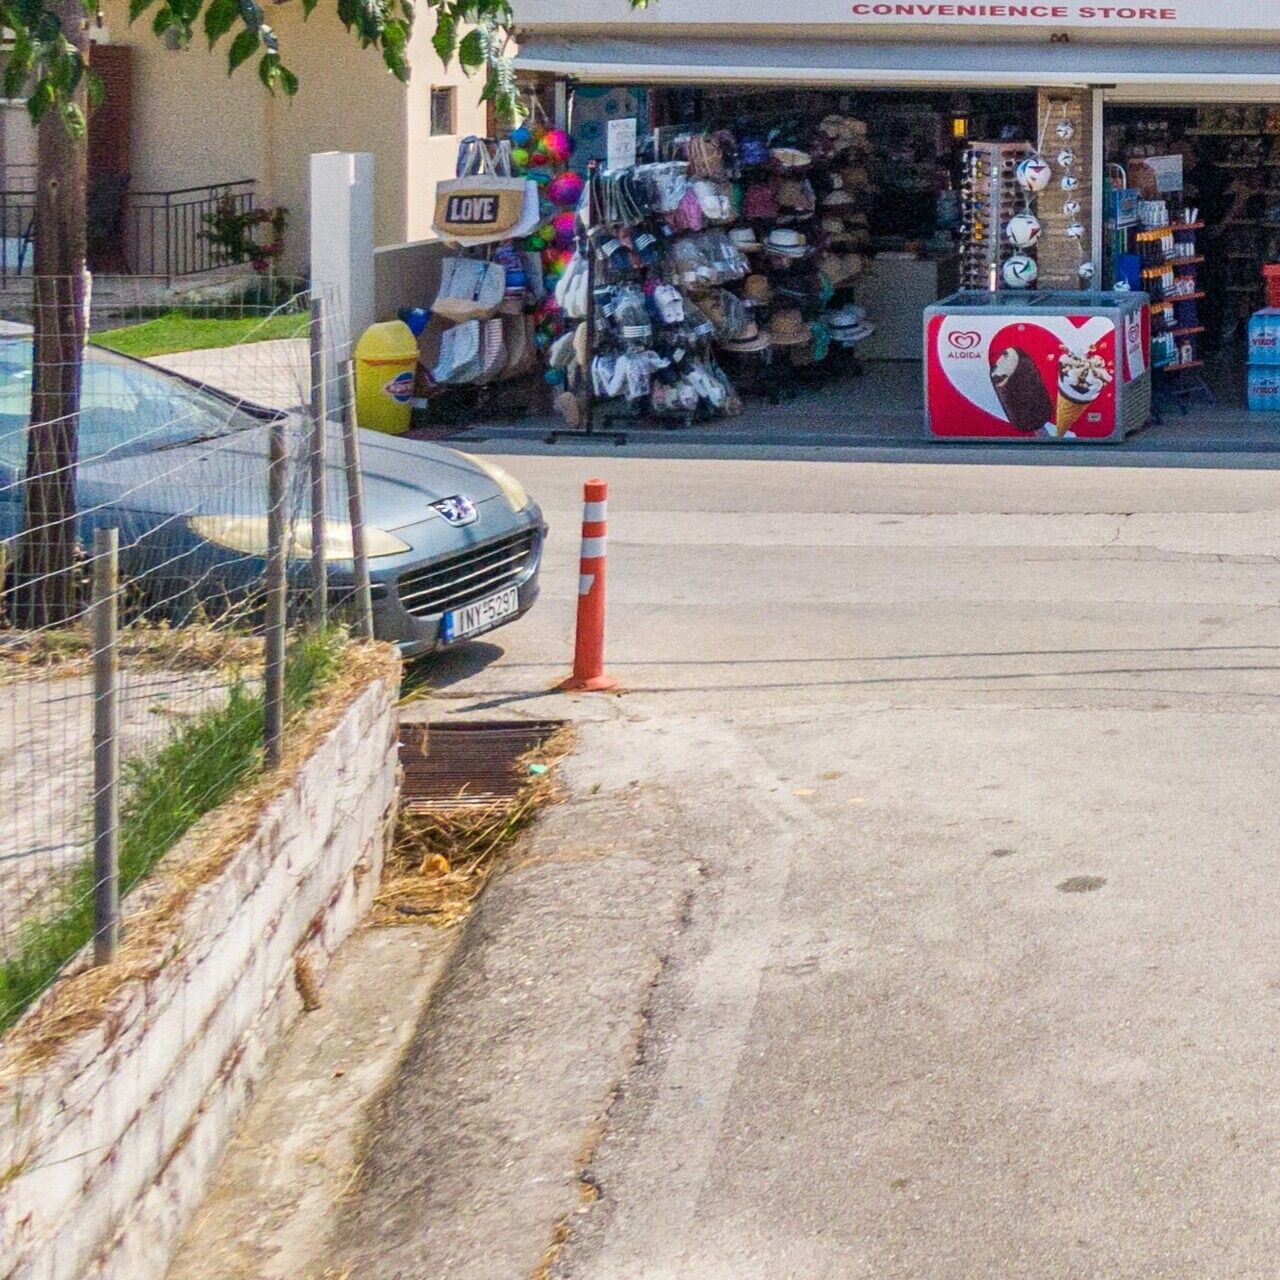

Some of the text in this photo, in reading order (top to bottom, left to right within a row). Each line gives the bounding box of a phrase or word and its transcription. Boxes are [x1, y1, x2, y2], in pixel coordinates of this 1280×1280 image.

[852, 3, 1176, 21] CONVENIENCE STORE
[451, 197, 494, 221] LOVE
